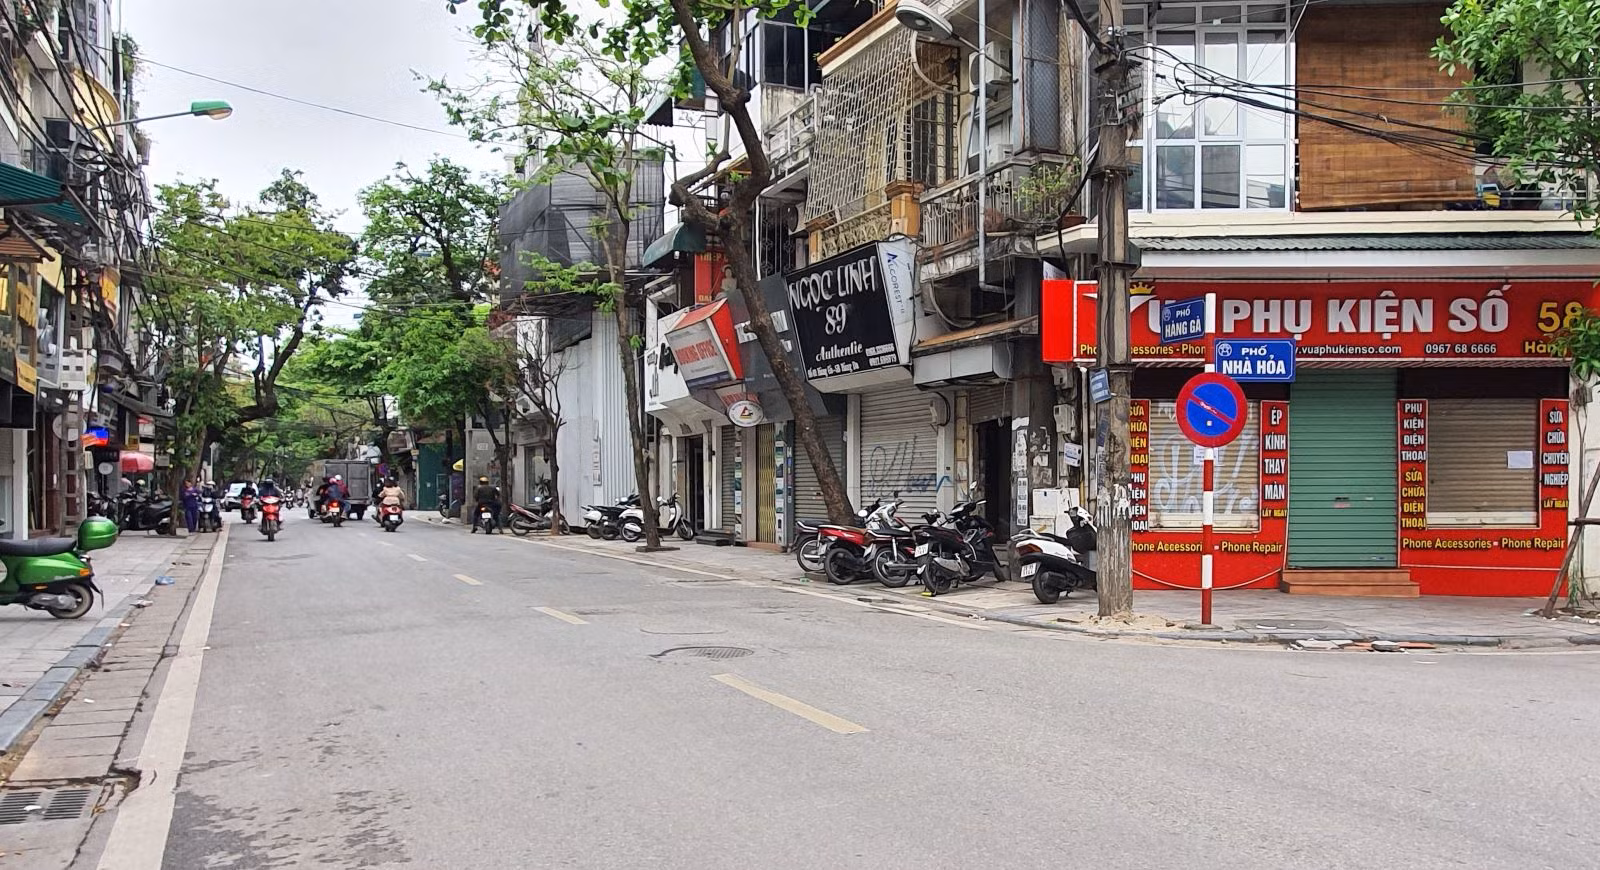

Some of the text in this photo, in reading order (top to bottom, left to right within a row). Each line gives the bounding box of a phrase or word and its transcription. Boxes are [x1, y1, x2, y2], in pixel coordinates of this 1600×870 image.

[789, 256, 879, 312] NGỌC LINH
[1176, 304, 1191, 318] PHỐ
[1222, 299, 1312, 340] PHỤ
[1328, 290, 1434, 340] KIỆN
[1448, 284, 1512, 333] SỐ
[824, 302, 847, 336] 89
[1165, 315, 1202, 338] HÀNG GÀ
[1181, 343, 1206, 355] Phon
[1241, 345, 1268, 356] PHỐ
[1425, 343, 1497, 354] 0967 68 6666
[1222, 355, 1286, 375] NHÀ HỎA
[1271, 406, 1283, 425] ÉP
[1405, 403, 1422, 415] PHỤ
[1549, 407, 1563, 423] SỬA
[1130, 419, 1148, 432] HỮA
[1403, 417, 1424, 432] KIỆN
[1265, 431, 1286, 450] KÍNH
[1403, 433, 1424, 448] ĐIỆN
[1401, 450, 1426, 463] THOẠI
[1543, 450, 1569, 465] CHUYÊN
[1264, 458, 1286, 474] THAY
[1405, 467, 1423, 481] SỬA
[1543, 471, 1569, 488] NGHIỆP
[1131, 487, 1146, 502] IỆN
[1264, 481, 1285, 500] MÀN
[1402, 484, 1425, 497] CHỮA
[1403, 501, 1424, 515] ĐIỆN
[1401, 517, 1426, 530] THOẠI
[1132, 540, 1154, 551] hone
[1157, 540, 1203, 552] Accessori
[1221, 541, 1250, 552] Phone
[1252, 541, 1283, 554] Repair
[1402, 537, 1432, 549] Phone
[1434, 537, 1492, 549] Accessories
[1501, 537, 1531, 549] Phone
[1534, 537, 1564, 550] Repair
